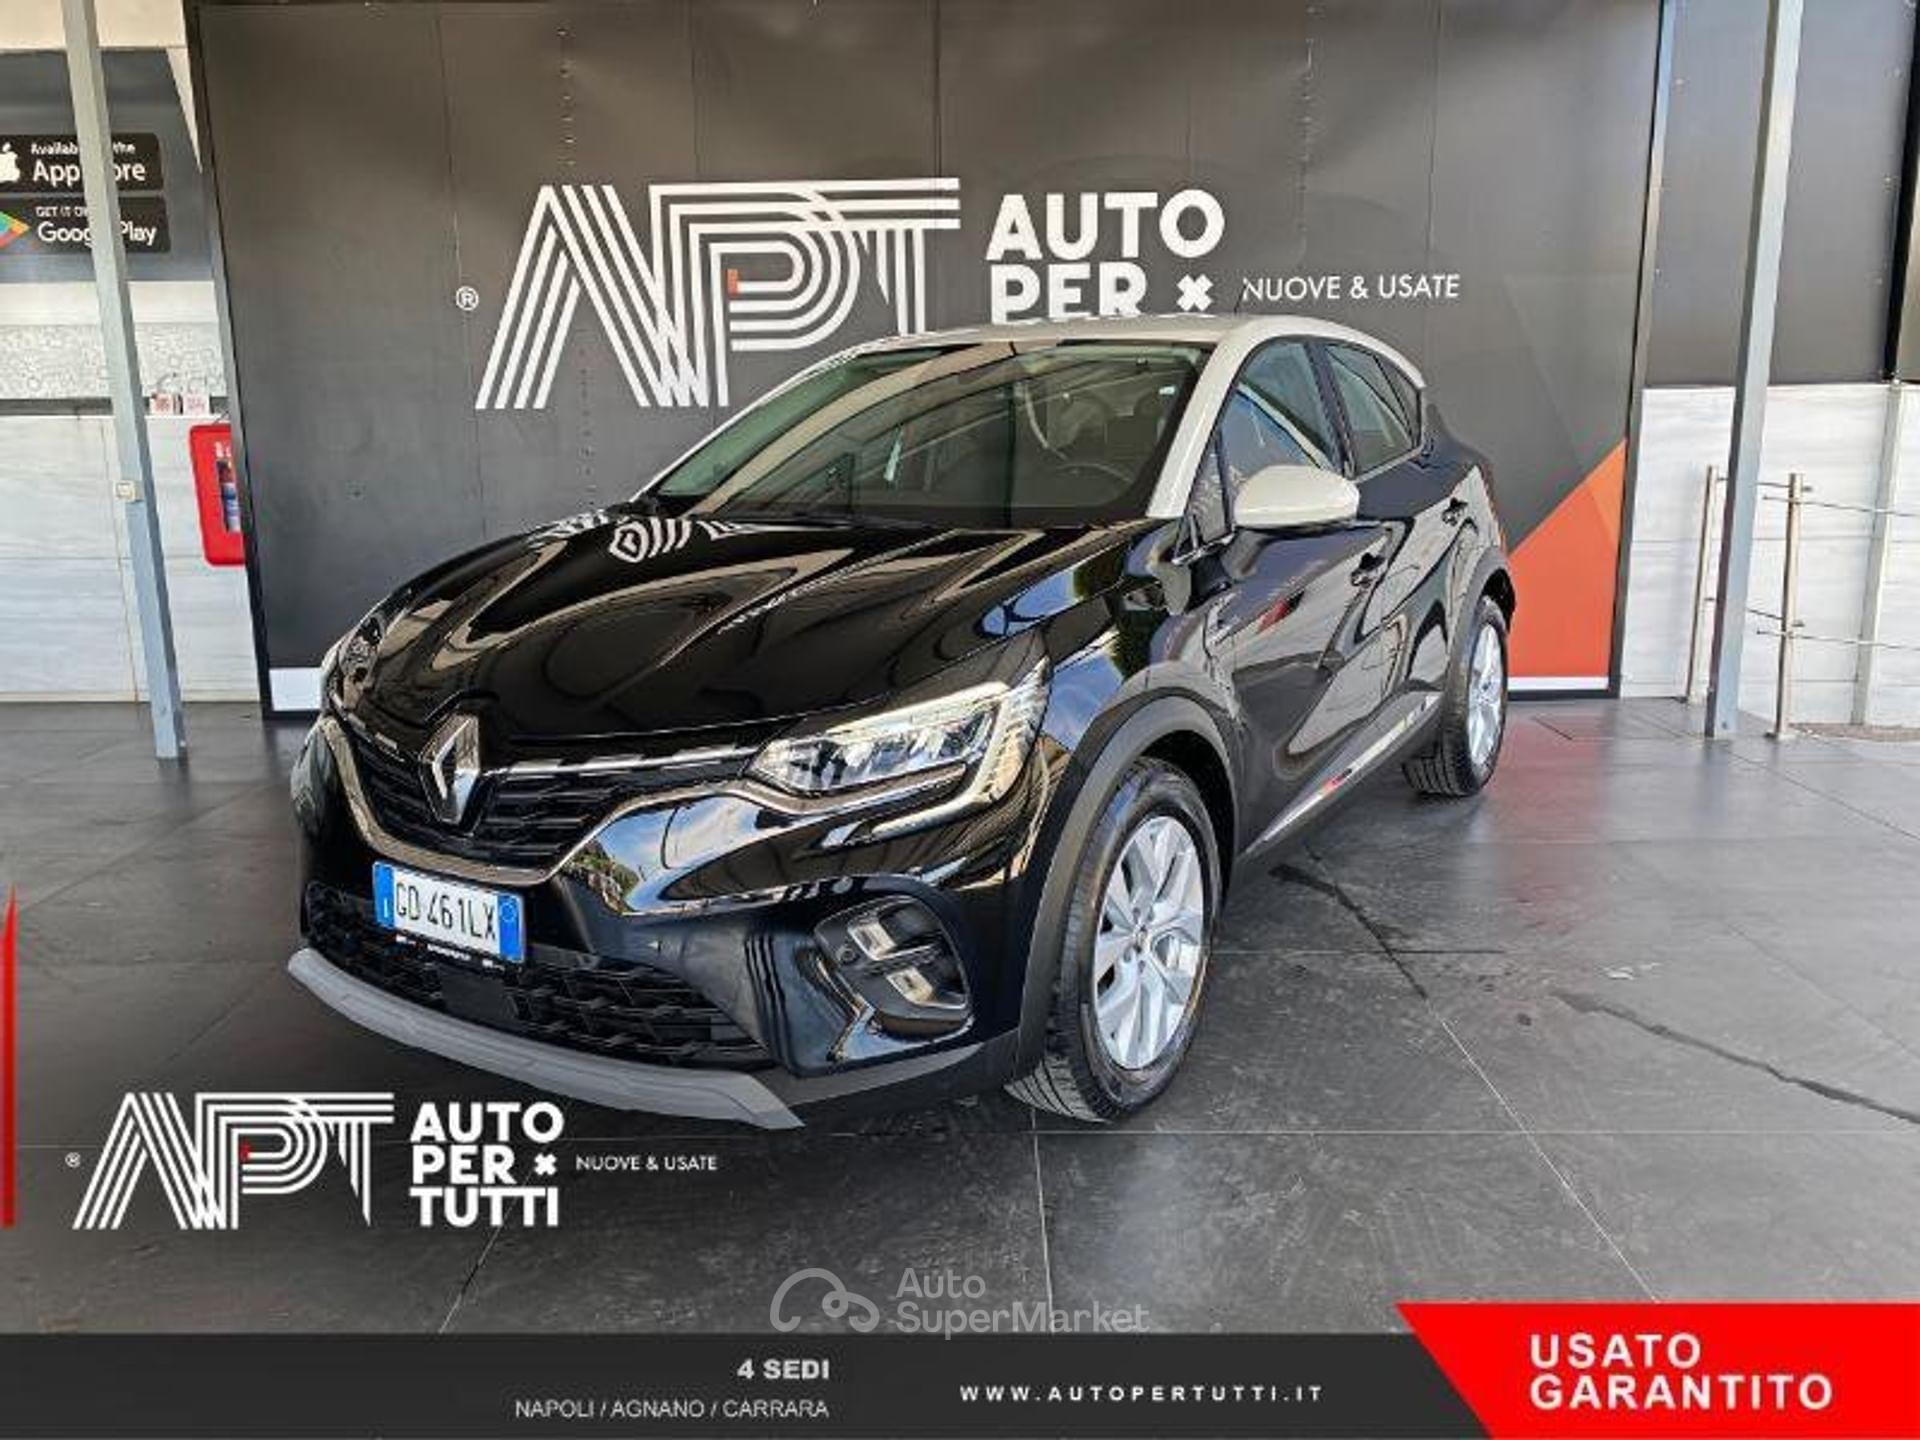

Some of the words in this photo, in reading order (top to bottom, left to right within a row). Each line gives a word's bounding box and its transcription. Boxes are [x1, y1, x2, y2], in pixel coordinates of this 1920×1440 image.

[31, 142, 79, 155] Availab
[32, 159, 81, 187] App
[37, 221, 94, 248] Goog
[986, 189, 1226, 260] AUTO
[991, 262, 1147, 324] PER
[1242, 275, 1342, 301] NUOVE
[1351, 275, 1370, 299] &
[1378, 273, 1461, 299] USATE
